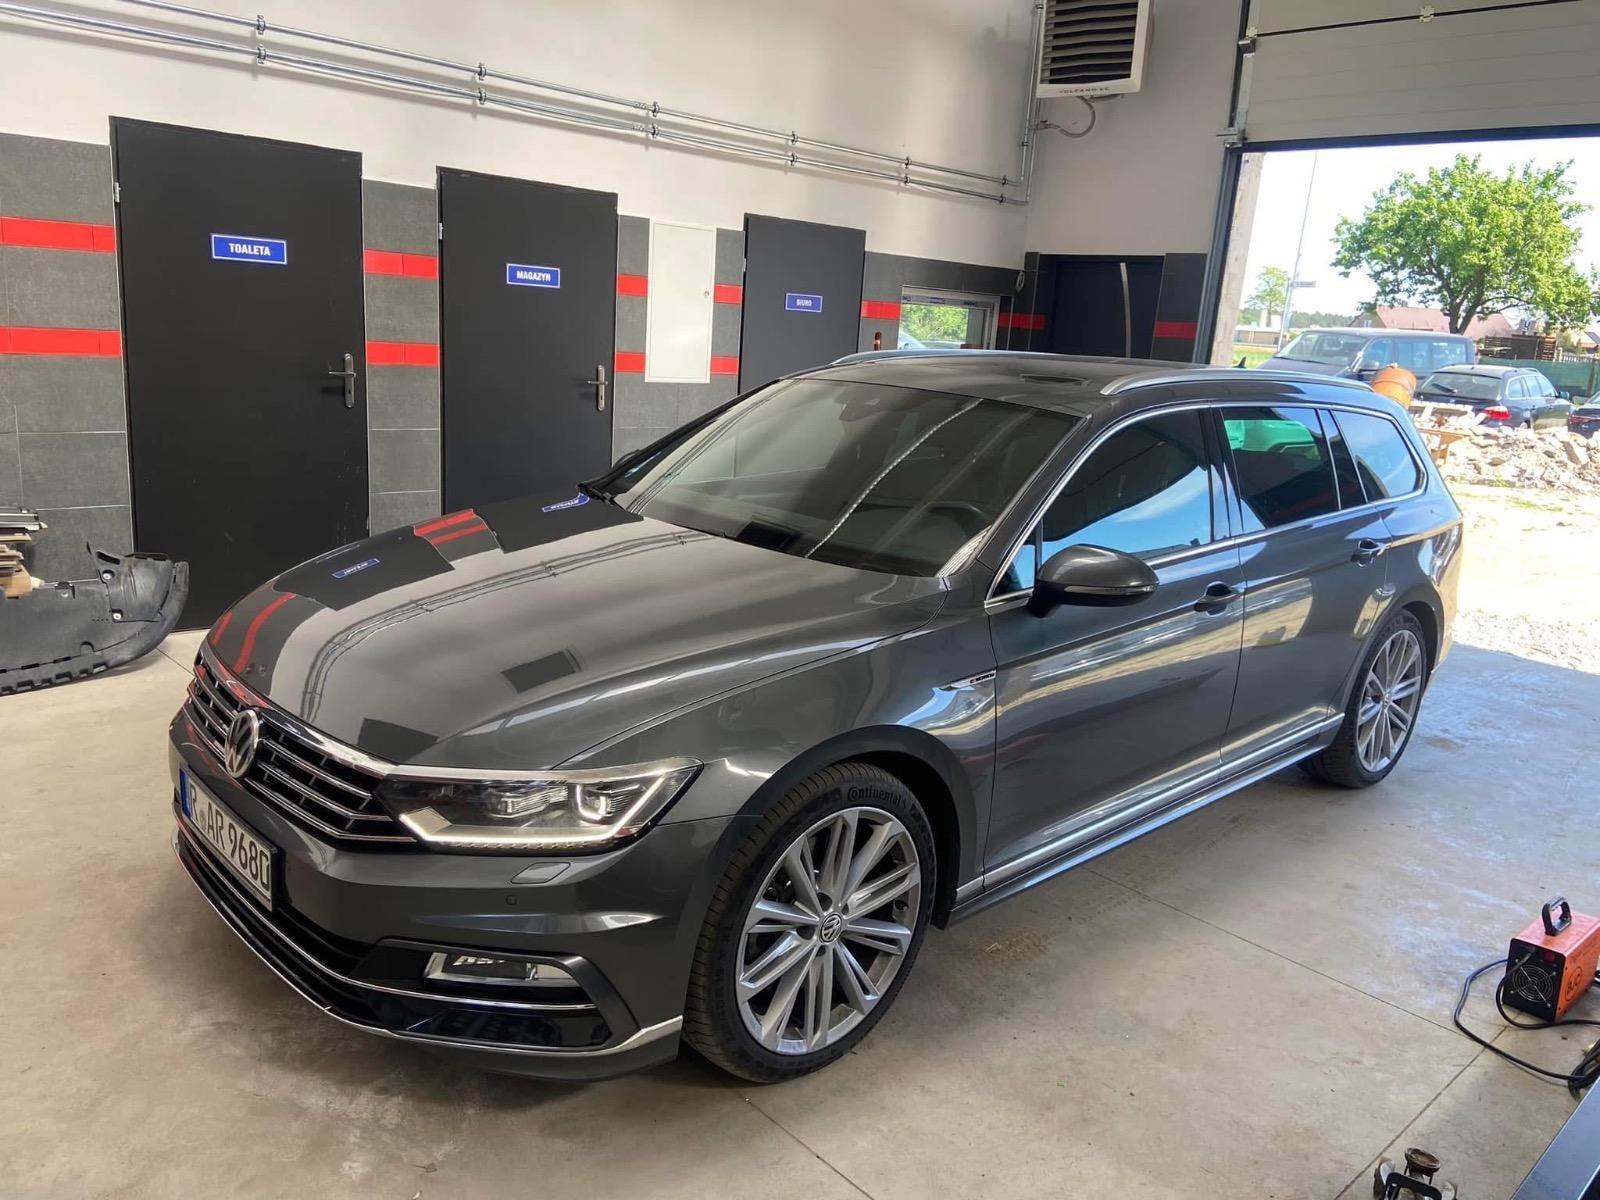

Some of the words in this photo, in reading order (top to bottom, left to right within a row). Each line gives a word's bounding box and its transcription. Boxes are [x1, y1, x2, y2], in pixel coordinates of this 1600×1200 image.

[228, 242, 271, 256] TOALETA
[516, 270, 551, 282] MAGAZYN
[847, 785, 902, 807] Continental
[189, 785, 199, 821] R
[207, 801, 226, 851] AR
[228, 823, 271, 892] 9680
